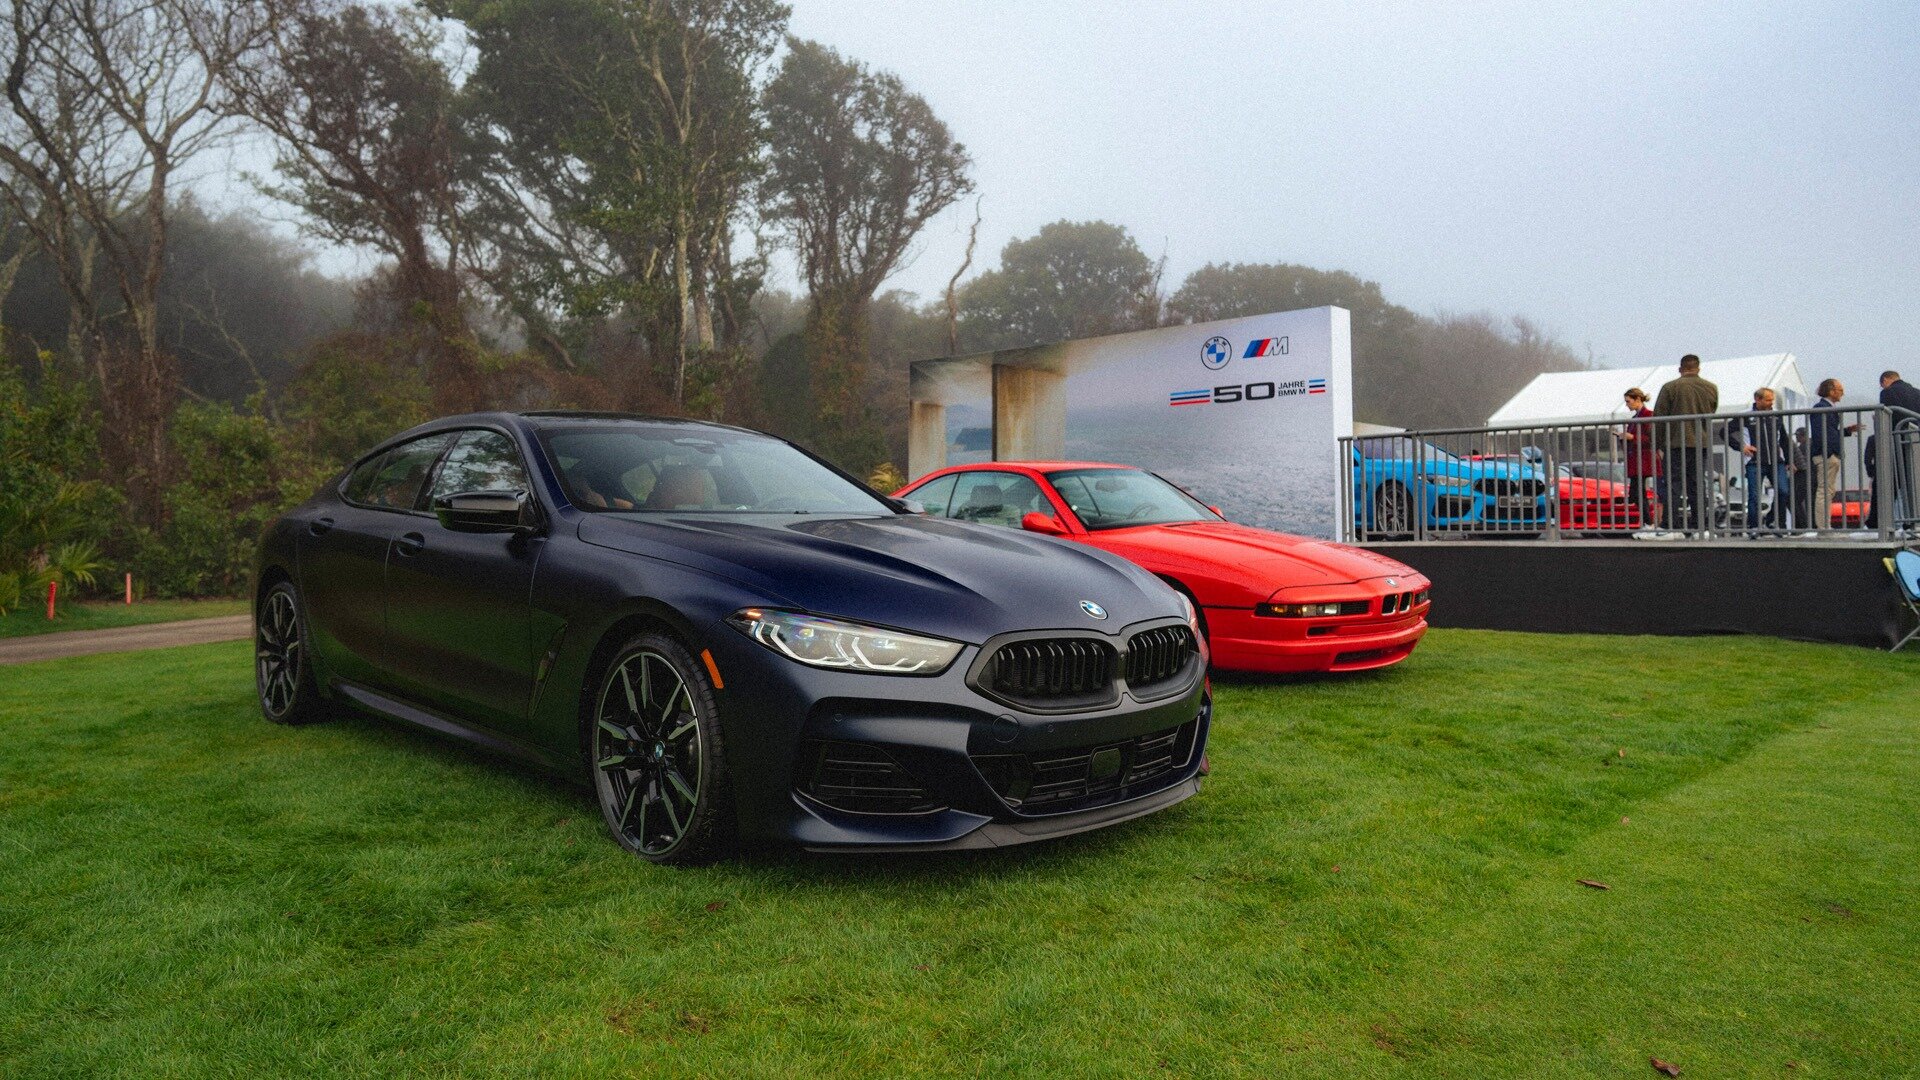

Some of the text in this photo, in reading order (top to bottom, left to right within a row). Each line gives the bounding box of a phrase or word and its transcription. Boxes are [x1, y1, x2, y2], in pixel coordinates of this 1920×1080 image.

[1278, 380, 1306, 390] JAHRE
[1214, 382, 1275, 404] 50
[1278, 389, 1298, 397] BMW
